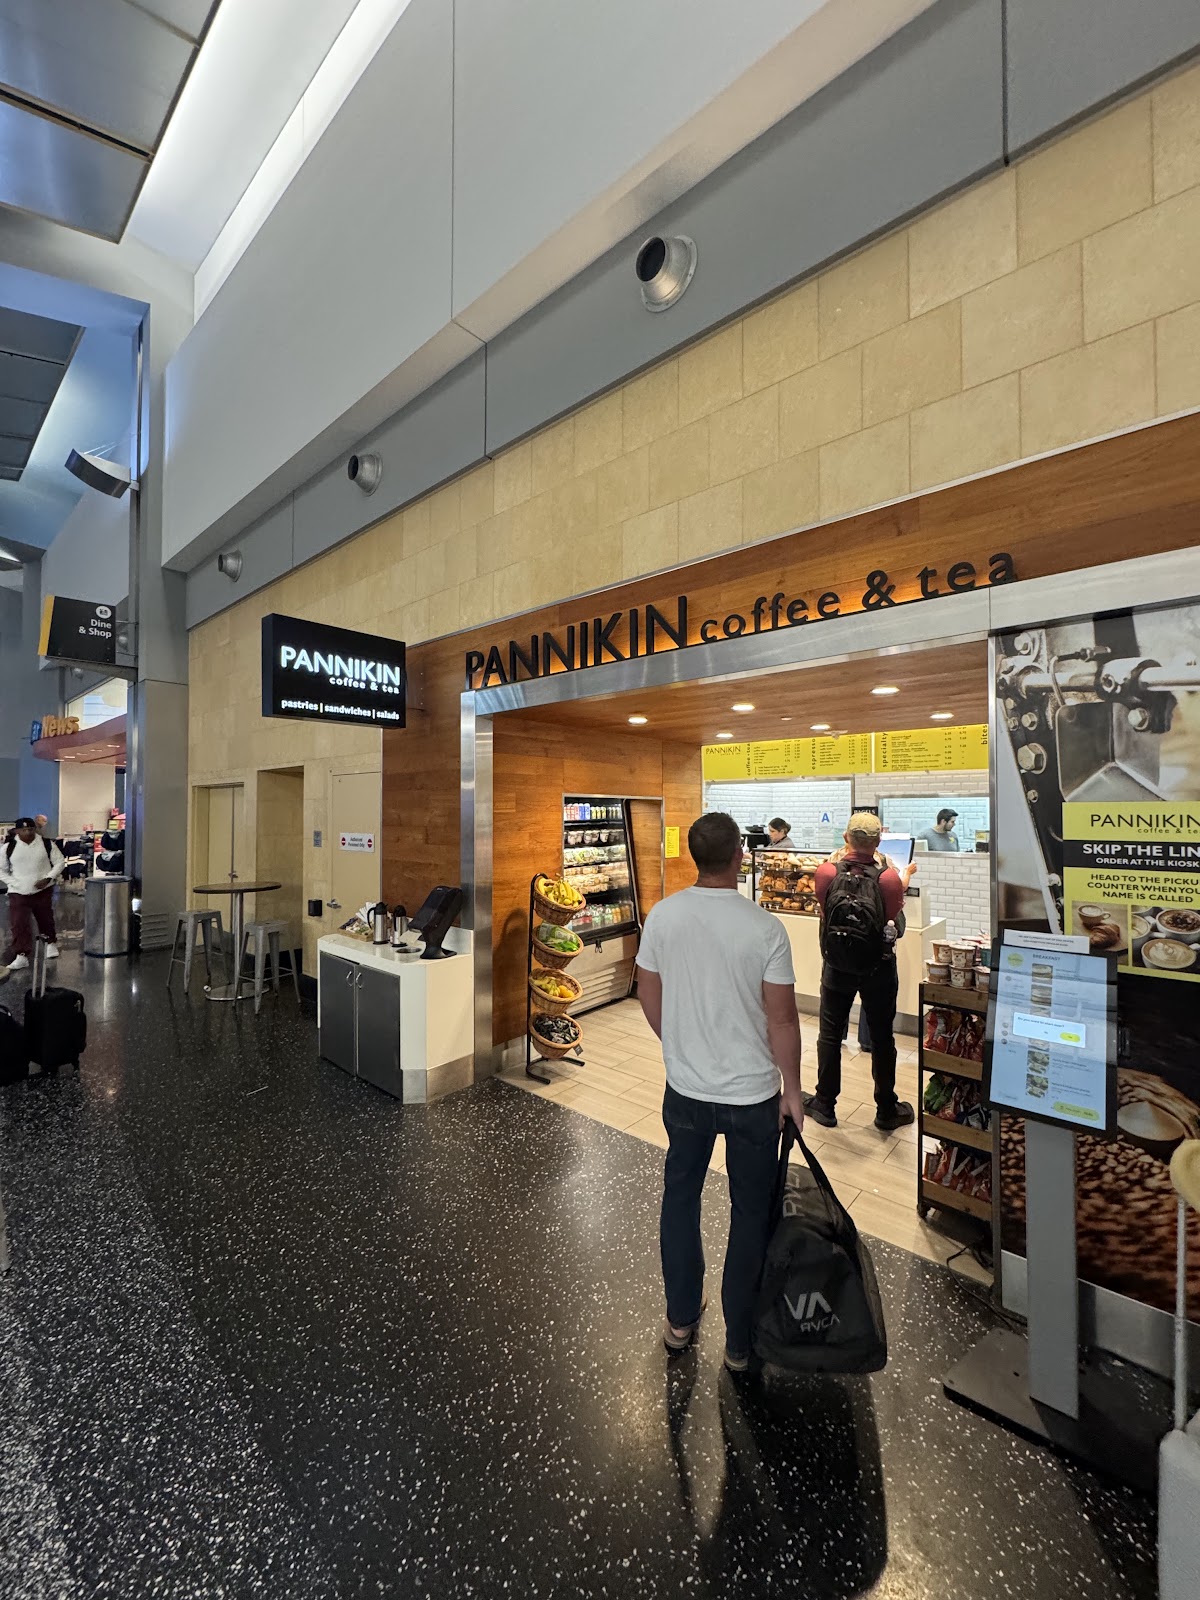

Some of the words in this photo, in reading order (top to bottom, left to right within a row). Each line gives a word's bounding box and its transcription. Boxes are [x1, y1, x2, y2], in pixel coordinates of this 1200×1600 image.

[90, 619, 112, 629] Dine
[465, 595, 688, 691] PANNIKIN
[700, 592, 841, 643] coffee
[861, 569, 897, 611] &
[917, 552, 1018, 600] tea
[78, 626, 86, 635] &
[88, 627, 112, 639] Shop
[280, 645, 401, 686] PANNIKIN
[329, 676, 366, 690] coffee
[370, 681, 379, 692] &
[382, 685, 400, 695] tea
[281, 699, 319, 711] pastries
[324, 704, 372, 718] sandwiches
[376, 710, 400, 720] salads
[42, 714, 81, 739] News
[705, 746, 741, 755] PANNIKIN
[820, 812, 830, 823] A
[1082, 843, 1122, 856] SKIP
[1123, 844, 1163, 857] THE
[1095, 857, 1129, 865] ORDER
[1129, 858, 1143, 866] AT
[1143, 859, 1166, 867] THE
[1167, 860, 1200, 868] KIOSK
[1090, 874, 1120, 882] HEAD
[1087, 882, 1139, 891] COUNTER
[1140, 885, 1177, 893] WHEN
[1102, 891, 1134, 899] NAME
[1148, 894, 1194, 903] CALLED
[1032, 953, 1061, 961] BREAKFAST
